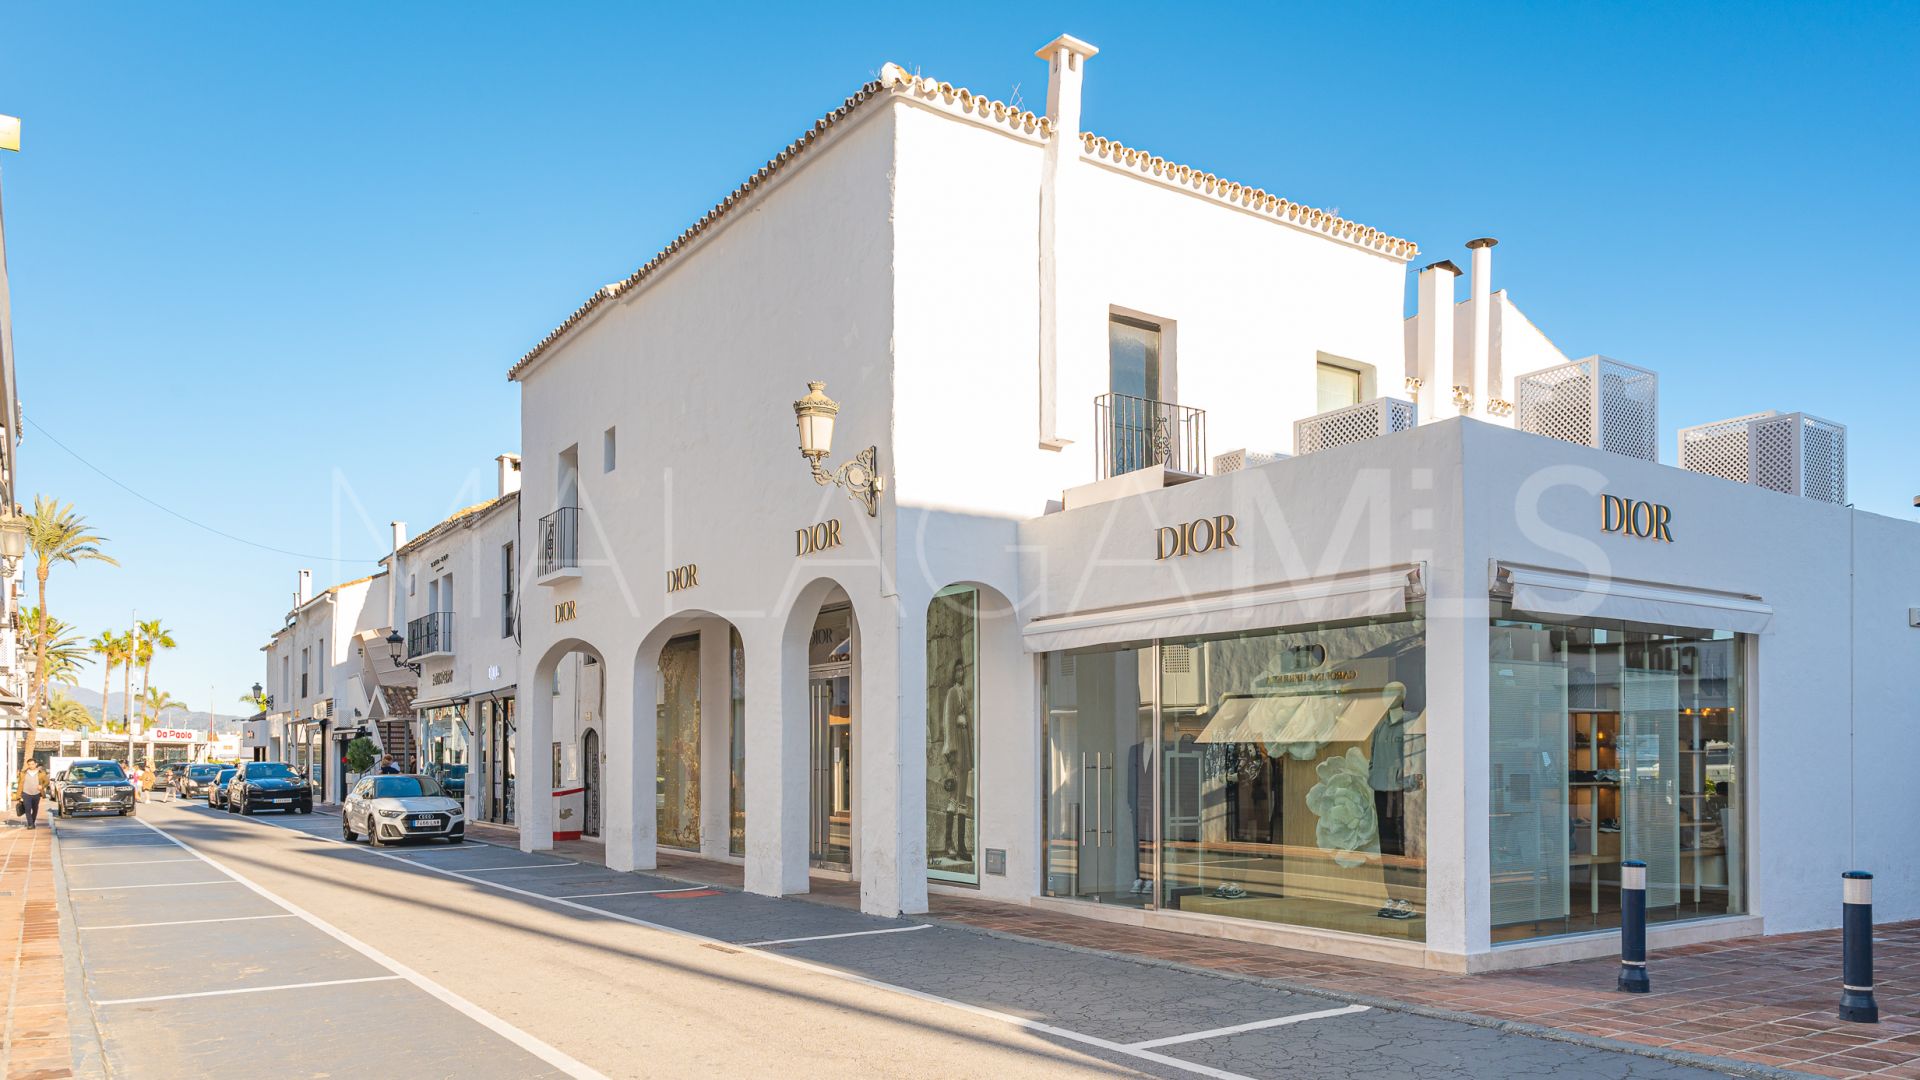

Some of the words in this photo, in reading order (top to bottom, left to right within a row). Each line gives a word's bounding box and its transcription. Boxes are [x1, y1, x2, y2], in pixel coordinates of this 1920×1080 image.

[1600, 493, 1674, 543] DIOR
[795, 518, 841, 556] DIOR
[1155, 513, 1239, 560] DIOR
[666, 563, 698, 592] DIOR
[555, 600, 577, 623] DIOR
[157, 730, 167, 738] Da
[169, 730, 192, 739] Paolo
